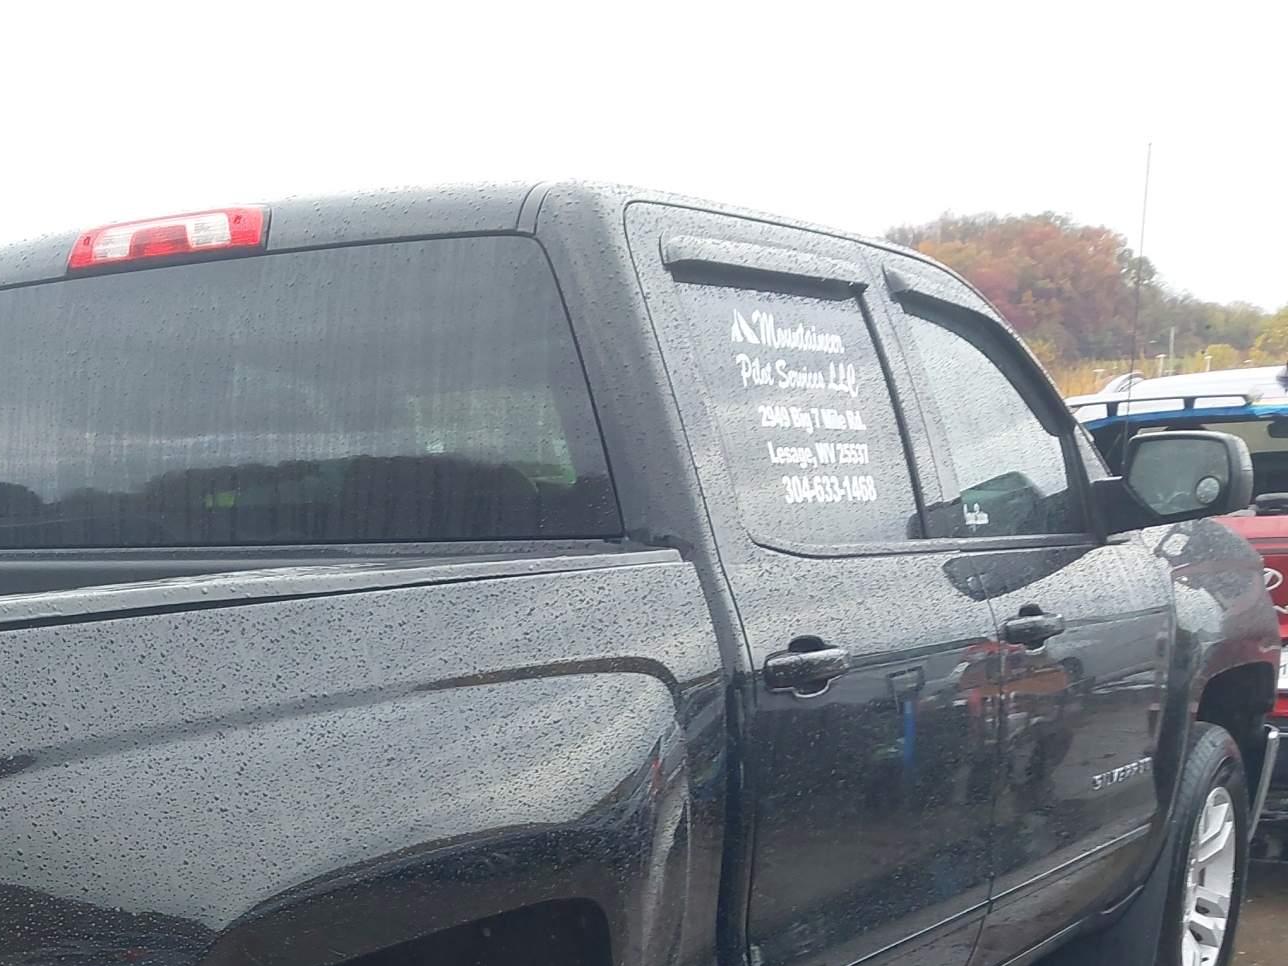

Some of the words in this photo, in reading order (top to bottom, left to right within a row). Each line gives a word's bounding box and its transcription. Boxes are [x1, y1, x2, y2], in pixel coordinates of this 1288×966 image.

[736, 353, 774, 388] Pilot
[789, 407, 813, 434] Big
[811, 408, 820, 428] 7
[814, 442, 836, 464] WV
